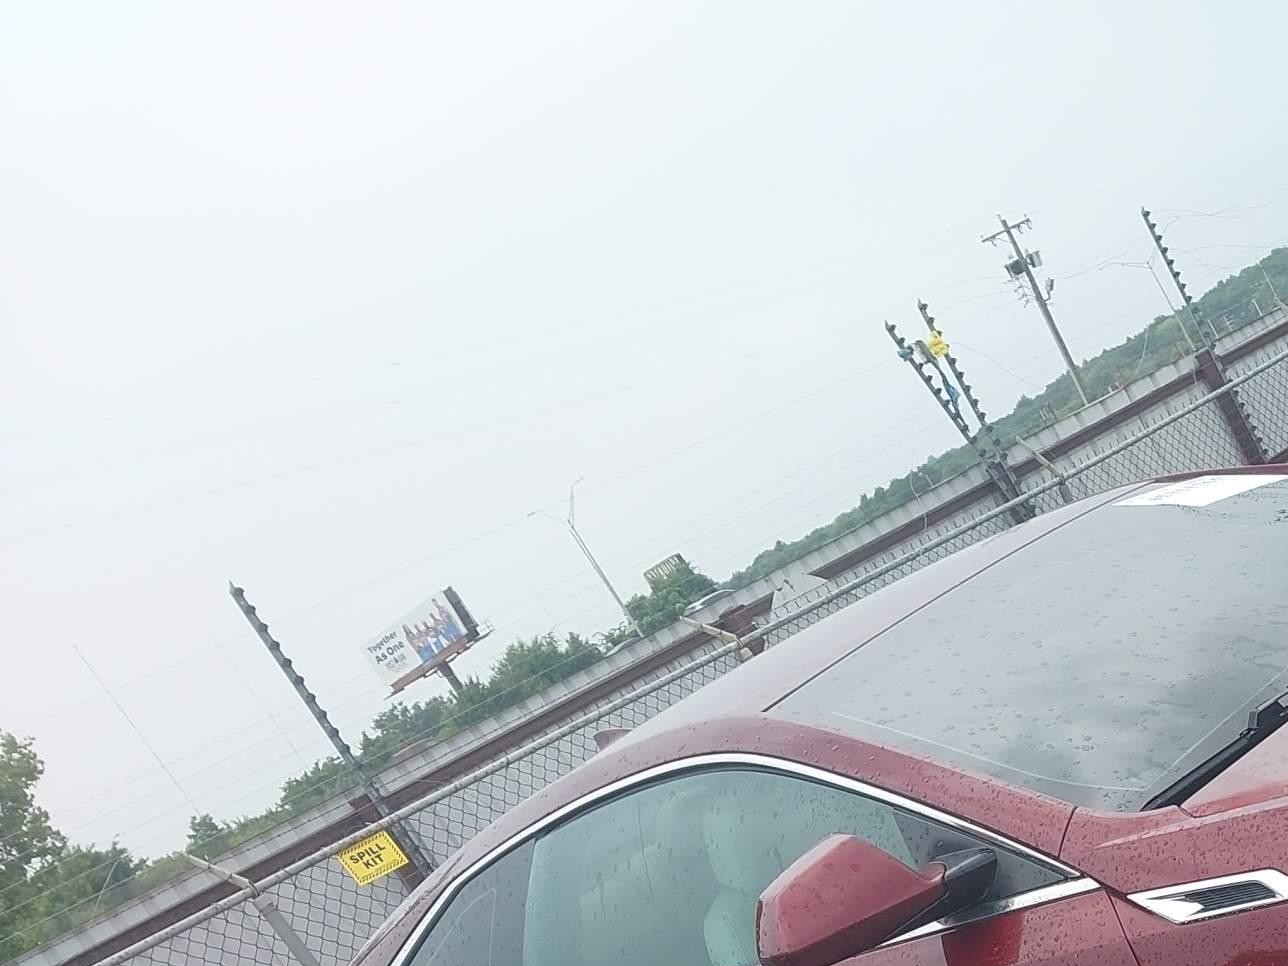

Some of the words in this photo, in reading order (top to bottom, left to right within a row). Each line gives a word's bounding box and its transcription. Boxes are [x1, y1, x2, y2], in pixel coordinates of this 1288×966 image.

[367, 631, 397, 654] Together
[375, 652, 388, 664] As
[386, 641, 405, 656] One
[349, 843, 387, 864] SPILL
[362, 853, 384, 869] KIT
